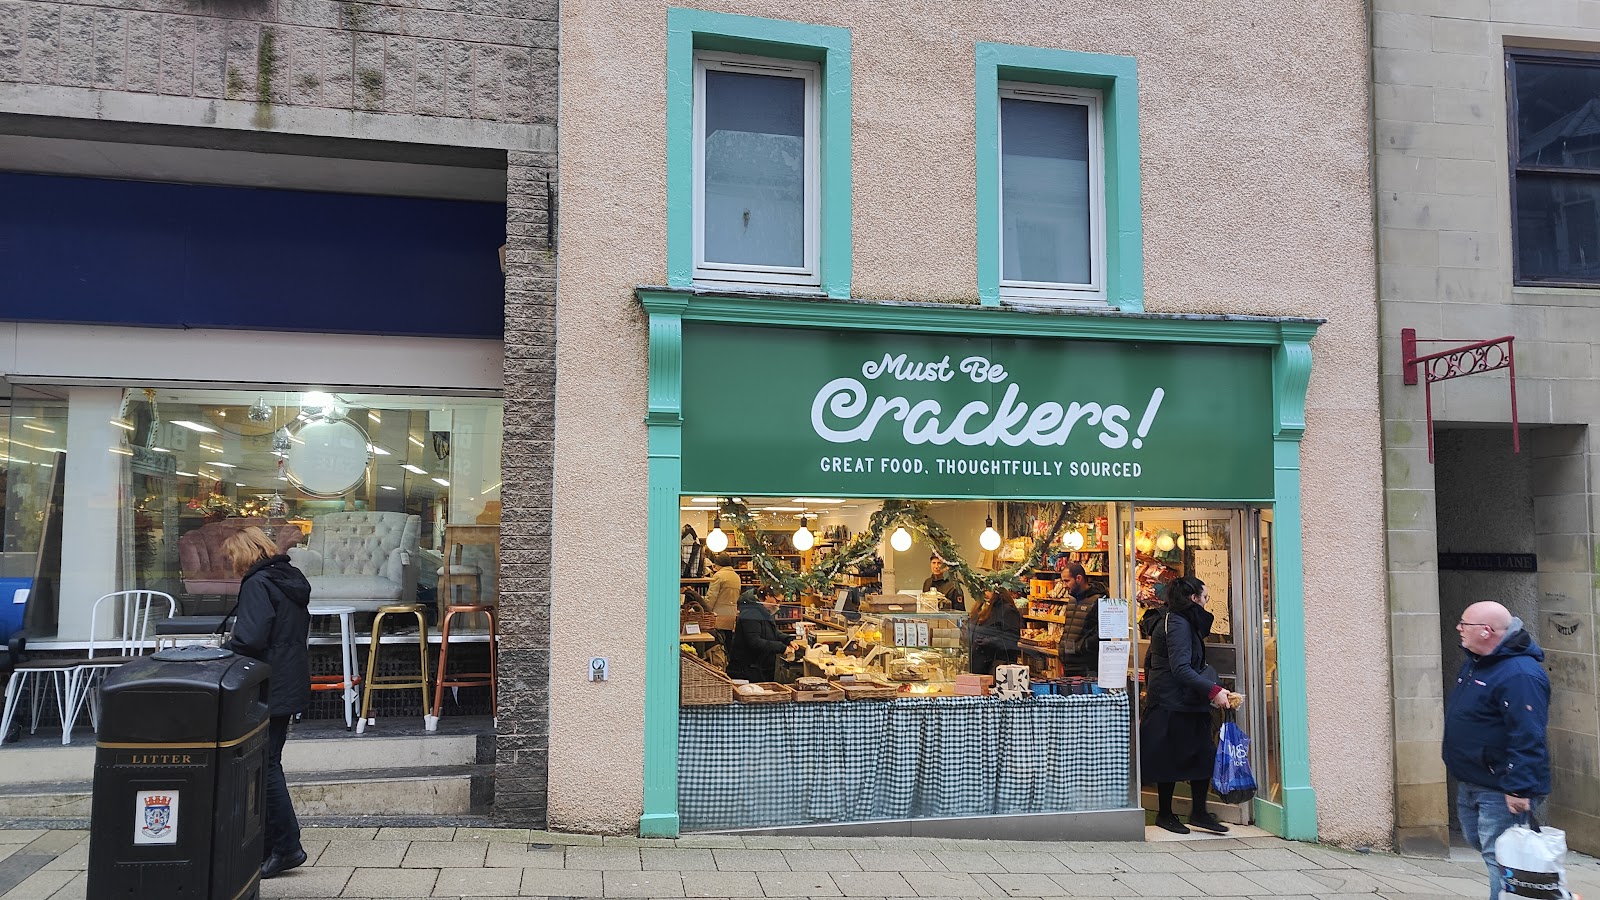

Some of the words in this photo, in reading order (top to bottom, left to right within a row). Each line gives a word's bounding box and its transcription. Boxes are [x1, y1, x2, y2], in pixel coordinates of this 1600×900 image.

[861, 352, 955, 382] Must
[959, 356, 1009, 383] Be
[810, 377, 1165, 450] Crackers!
[819, 456, 875, 473] GREAT
[935, 458, 1063, 477] THOUGHTFULLY
[1069, 461, 1142, 478] SOURCED
[1497, 556, 1532, 569] LANE
[132, 754, 191, 764] LITTER
